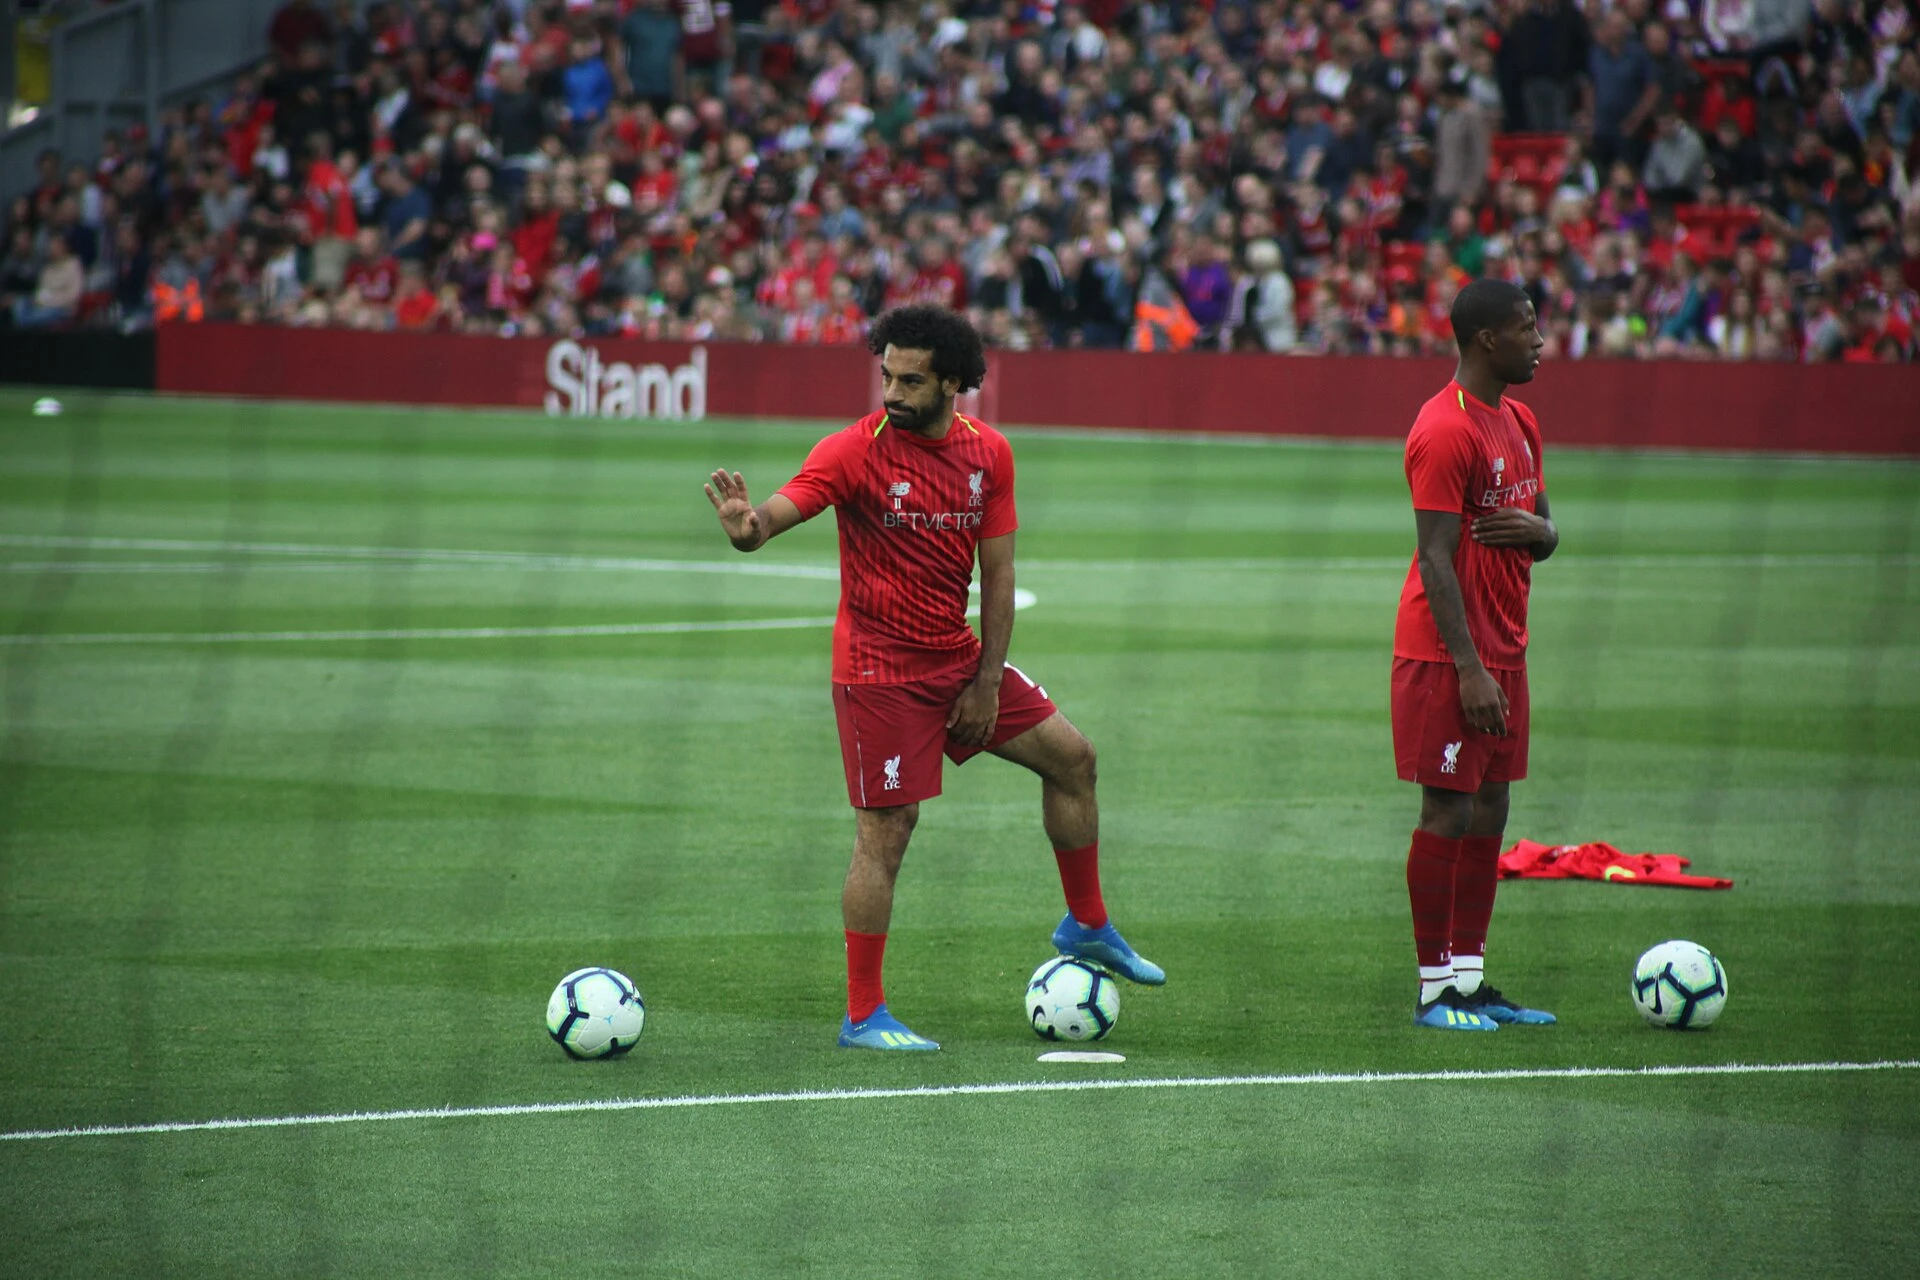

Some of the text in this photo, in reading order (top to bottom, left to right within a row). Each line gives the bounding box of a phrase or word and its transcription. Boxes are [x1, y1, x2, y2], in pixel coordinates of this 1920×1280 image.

[545, 340, 707, 420] Stand
[1496, 473, 1502, 486] 5
[968, 498, 983, 507] LFC
[884, 511, 983, 530] BETVICTOR
[884, 781, 901, 790] LFC
